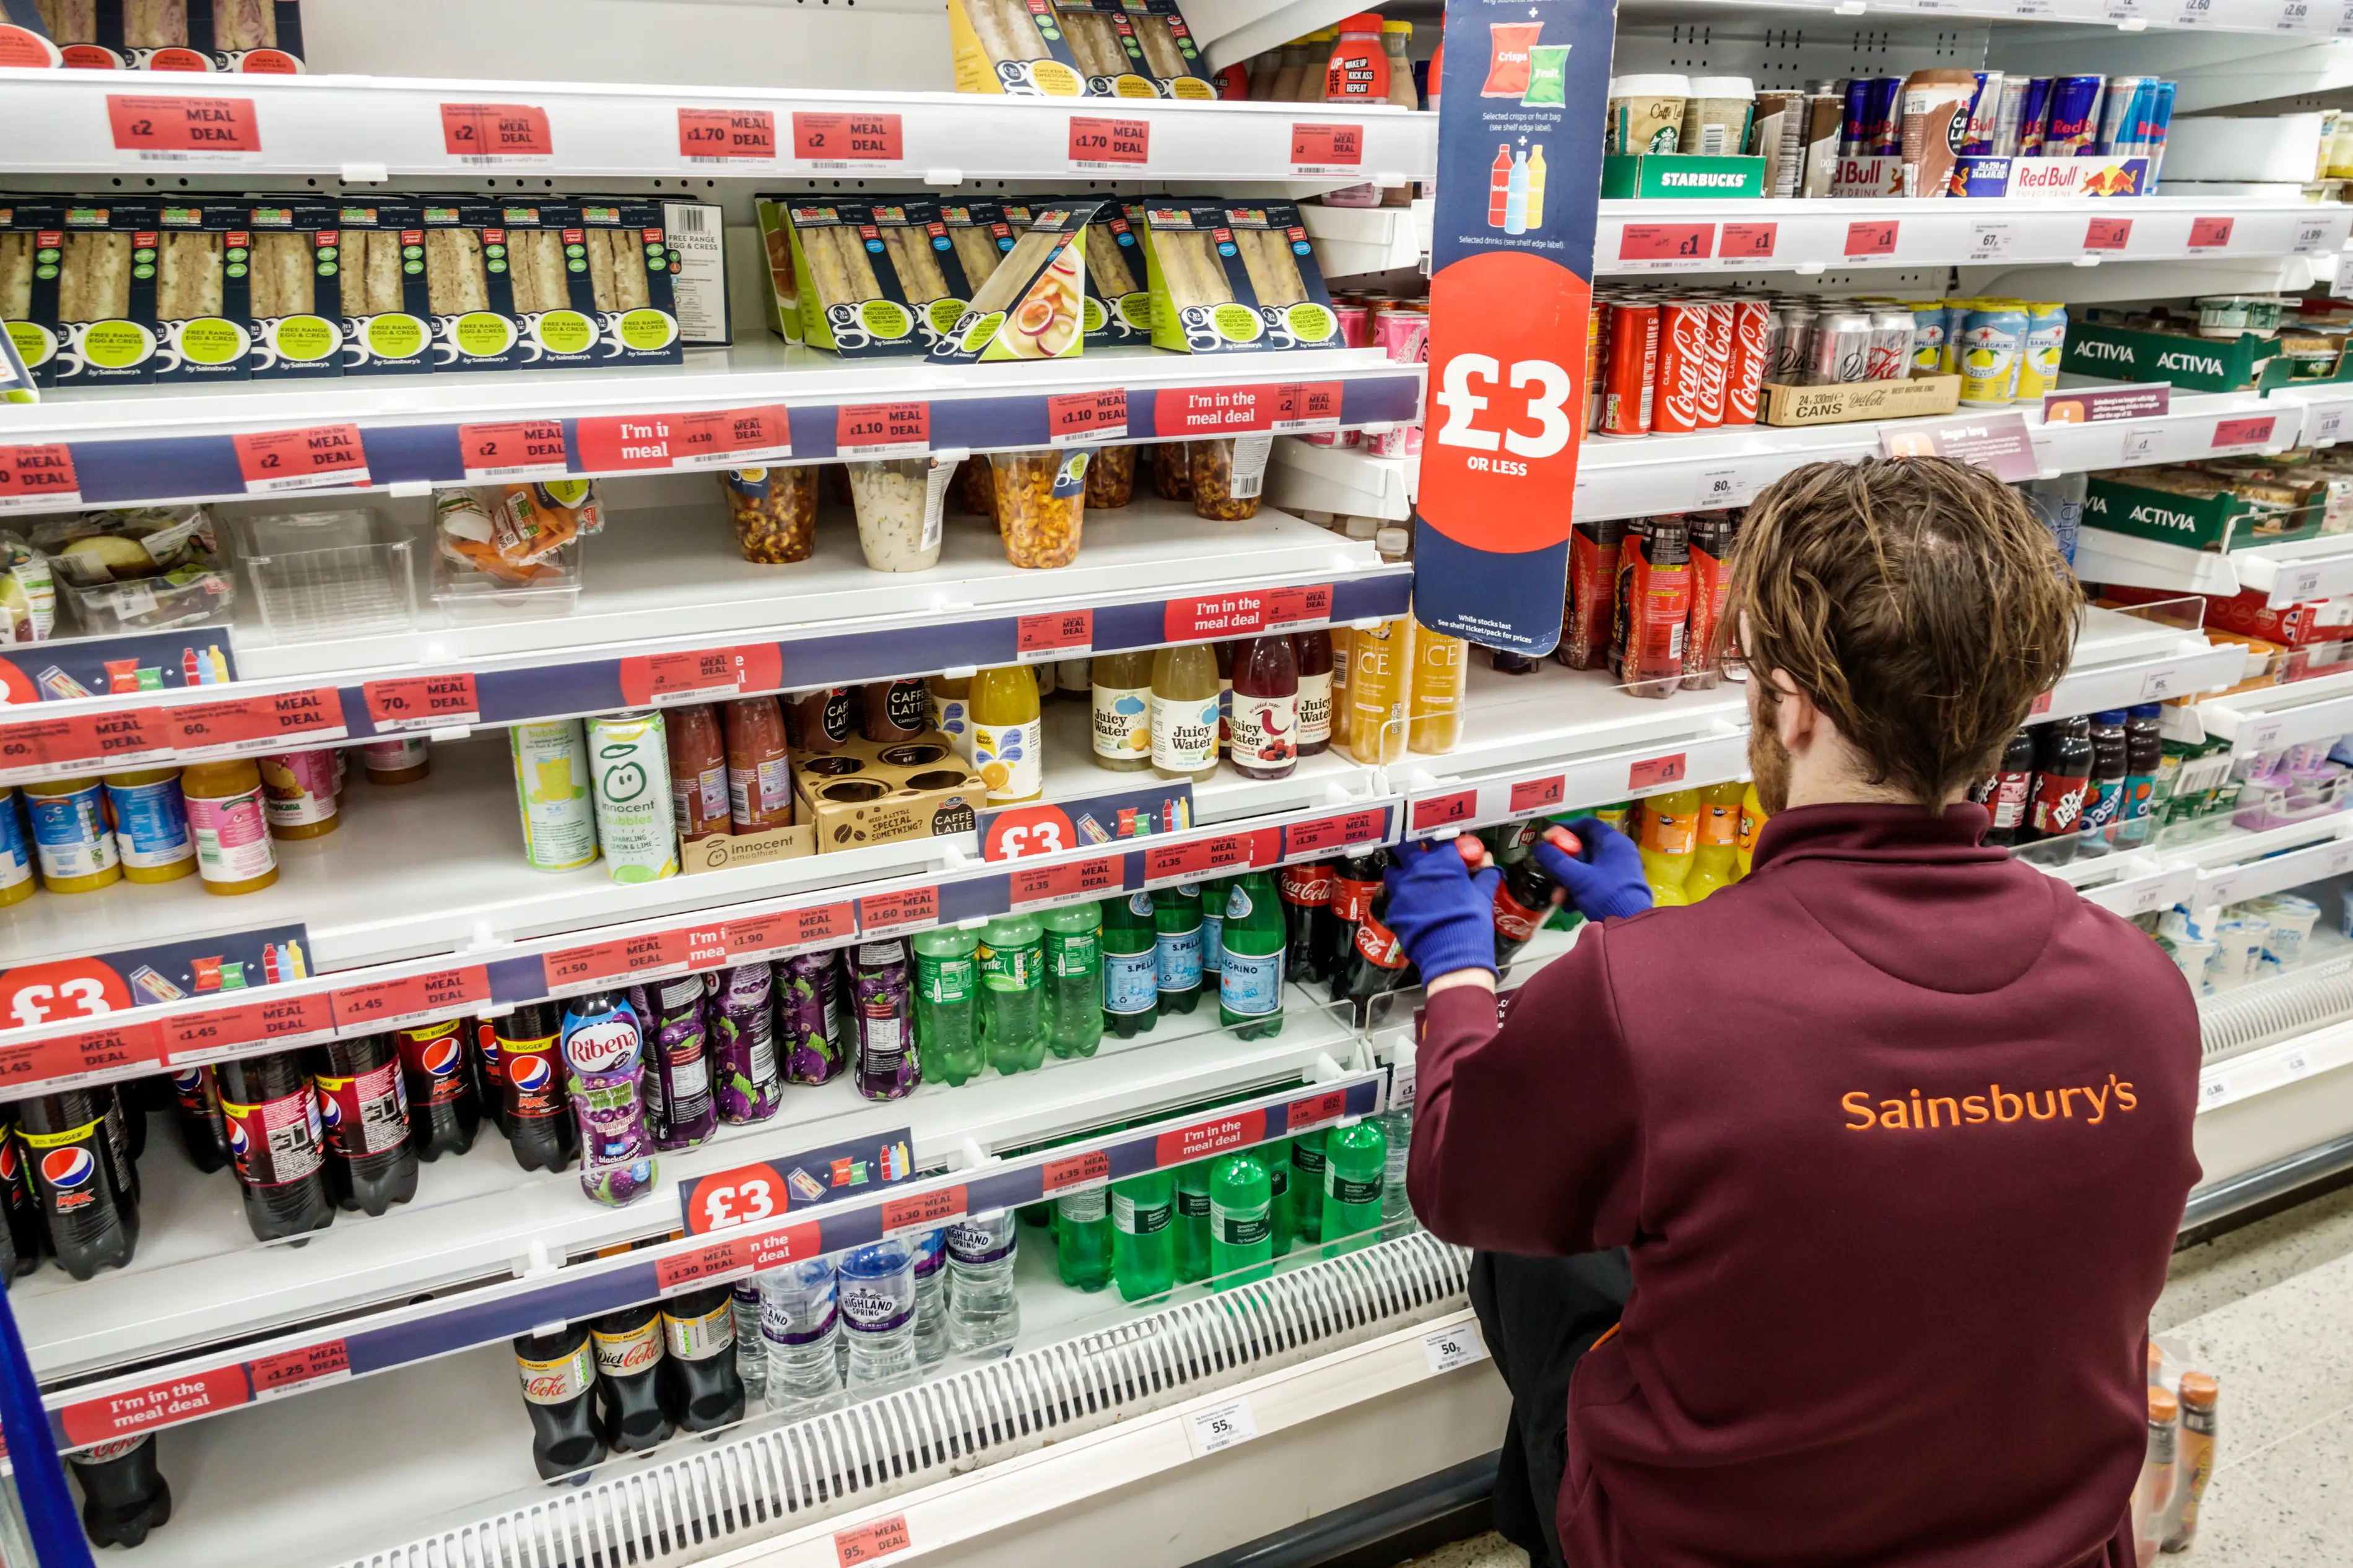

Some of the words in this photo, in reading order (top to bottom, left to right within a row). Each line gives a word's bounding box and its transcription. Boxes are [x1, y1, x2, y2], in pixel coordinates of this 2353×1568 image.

[2186, 0, 2210, 9] £2.60
[1331, 58, 1343, 69] UP
[1345, 59, 1360, 69] WAKE
[1359, 59, 1367, 67] UP
[1498, 52, 1528, 63] Crisps
[1329, 70, 1340, 82] BE
[1349, 72, 1362, 80] KICK
[1363, 72, 1373, 80] ASS
[1535, 69, 1559, 78] Fruit
[1329, 83, 1339, 95] AT
[1347, 84, 1367, 93] REPEAT
[186, 109, 236, 123] MEAL
[1510, 113, 1527, 123] crisps
[1549, 113, 1561, 122] bag
[131, 120, 154, 136] £2
[731, 117, 770, 130] MEAL
[850, 124, 886, 135] MEAL
[1519, 124, 1534, 132] edge
[1534, 124, 1552, 132] label).
[2053, 119, 2082, 134] Red
[190, 128, 238, 142] DEAL
[455, 126, 474, 140] £2
[687, 128, 724, 141] £1.70
[733, 134, 770, 145] DEAL
[1114, 127, 1144, 138] MEAL
[809, 134, 825, 147] £2
[852, 140, 886, 150] DEAL
[1076, 136, 1107, 147] £1.70
[1113, 142, 1143, 153] DEAL
[1661, 173, 1744, 188] STARBUCKS
[2019, 167, 2049, 186] Red
[2049, 167, 2078, 186] Bull
[668, 235, 689, 243] FREE
[691, 235, 715, 243] RANGE
[1459, 236, 1483, 244] Selected
[1484, 236, 1502, 245] drinks
[1504, 238, 1516, 246] (see
[1516, 239, 1531, 247] shelf
[1531, 240, 1544, 248] edge
[1680, 234, 1698, 255] £1
[1756, 232, 1770, 248] £1
[1879, 231, 1891, 245] £1
[1983, 235, 1998, 247] 67p
[2074, 340, 2134, 363] ACTIVIA
[1663, 353, 1672, 386] CLASSIC
[2157, 352, 2224, 376] ACTIVIA
[1188, 392, 1212, 407] I'm
[1216, 392, 1228, 405] in
[1231, 391, 1255, 405] the
[1280, 399, 1292, 411] £2
[1309, 395, 1330, 404] MEAL
[1437, 353, 1571, 458] £3
[1309, 403, 1329, 411] DEAL
[1796, 403, 1842, 418] CANS
[1062, 409, 1092, 423] £1.10
[1186, 409, 1222, 427] meal
[1224, 408, 1255, 423] deal
[733, 422, 762, 431] MEAL
[850, 422, 883, 435] £1.10
[736, 430, 762, 440] DEAL
[1468, 456, 1489, 471] OR
[1492, 459, 1527, 477] LESS
[1714, 480, 1731, 492] 80p
[1196, 602, 1220, 615] I'm
[1223, 601, 1236, 614] in
[1238, 599, 1260, 613] the
[1194, 615, 1230, 631] meal
[1232, 612, 1259, 625] deal
[1458, 614, 1477, 623] While
[1477, 617, 1498, 628] stocks
[1498, 622, 1511, 630] last
[1450, 621, 1464, 633] shelf
[1466, 625, 1502, 638] ticket/pack
[1513, 631, 1532, 644] prices
[1357, 649, 1388, 676] ICE
[382, 697, 411, 711] 70p
[1095, 708, 1128, 727] Juicy
[1094, 719, 1129, 736] Water
[1173, 725, 1211, 738] Juicy
[1172, 736, 1212, 750] Water
[602, 800, 655, 813] innocent
[2060, 789, 2077, 810] Dr
[888, 808, 910, 820] LITTLE
[935, 809, 972, 825] CAFFÈ
[2079, 785, 2123, 838] Oasis
[605, 813, 653, 826] bubbles
[872, 816, 912, 830] SPECIAL
[935, 818, 973, 834] LATTE
[871, 820, 923, 841] SOMETHING?
[1521, 831, 1536, 842] up
[612, 834, 647, 842] SPARKLING
[731, 835, 793, 854] innocent
[1296, 834, 1317, 845] £1.35
[732, 849, 778, 862] smoothies
[1157, 857, 1180, 868] £1.35
[799, 914, 832, 927] MEAL
[868, 909, 898, 922] £1.60
[733, 933, 763, 946] £1.90
[801, 927, 832, 938] DEAL
[557, 963, 588, 976] £1.50
[180, 1026, 217, 1041] £1.45
[571, 1031, 637, 1060] Ribena
[1842, 1073, 2137, 1130] Sainsbury's
[1184, 1130, 1204, 1143] I'm
[1207, 1128, 1222, 1140] in
[1225, 1121, 1241, 1133] the
[607, 1144, 623, 1155] light
[1183, 1138, 1212, 1155] meal
[1214, 1132, 1240, 1149] deal
[598, 1141, 643, 1164] blackcurrant
[56, 1189, 95, 1208] MAX
[924, 1195, 952, 1206] MEAL
[925, 1205, 952, 1218] DEAL
[763, 1235, 789, 1247] the
[758, 1247, 789, 1264] deal
[669, 1265, 698, 1280] £1.30
[843, 1297, 892, 1311] HIGHLAND
[597, 1348, 624, 1368] Diet
[624, 1336, 658, 1367] Coke
[1441, 1341, 1461, 1355] 50p
[267, 1365, 305, 1382] £1.25
[529, 1373, 567, 1397] Coke
[110, 1397, 145, 1413] I'm
[149, 1390, 169, 1404] in
[172, 1381, 206, 1398] the
[113, 1407, 165, 1427] meal
[168, 1393, 210, 1414] deal
[1211, 1419, 1233, 1434] 55p
[844, 1545, 864, 1559] 95p
